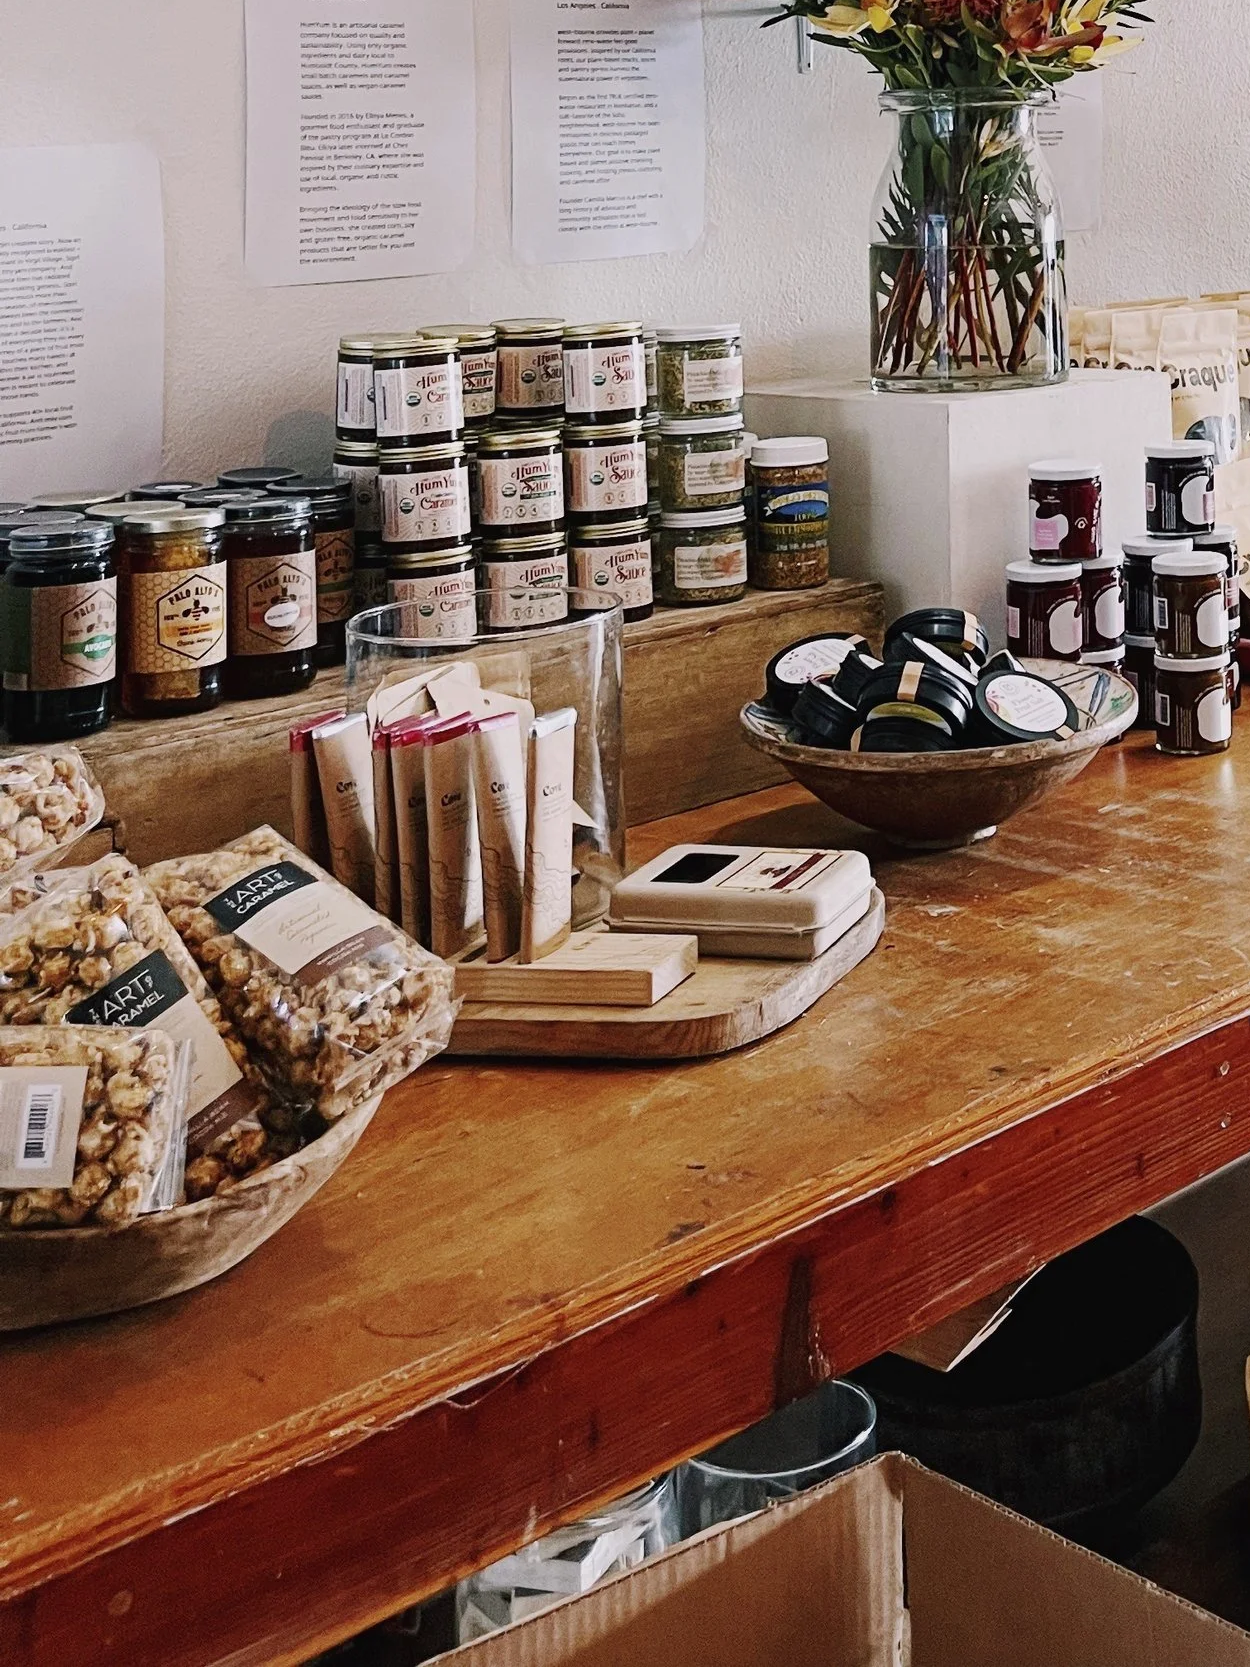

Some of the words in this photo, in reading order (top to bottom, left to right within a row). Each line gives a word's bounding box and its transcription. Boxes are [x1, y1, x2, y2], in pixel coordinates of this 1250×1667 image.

[540, 364, 562, 382] Sau
[612, 366, 634, 384] Sau
[257, 575, 279, 592] PALO
[615, 565, 646, 584] Sauce
[167, 588, 191, 606] PALO
[236, 869, 278, 904] ART
[236, 879, 295, 915] CARAMEL
[102, 968, 150, 1020] ART
[111, 990, 165, 1028] ARAMEL
